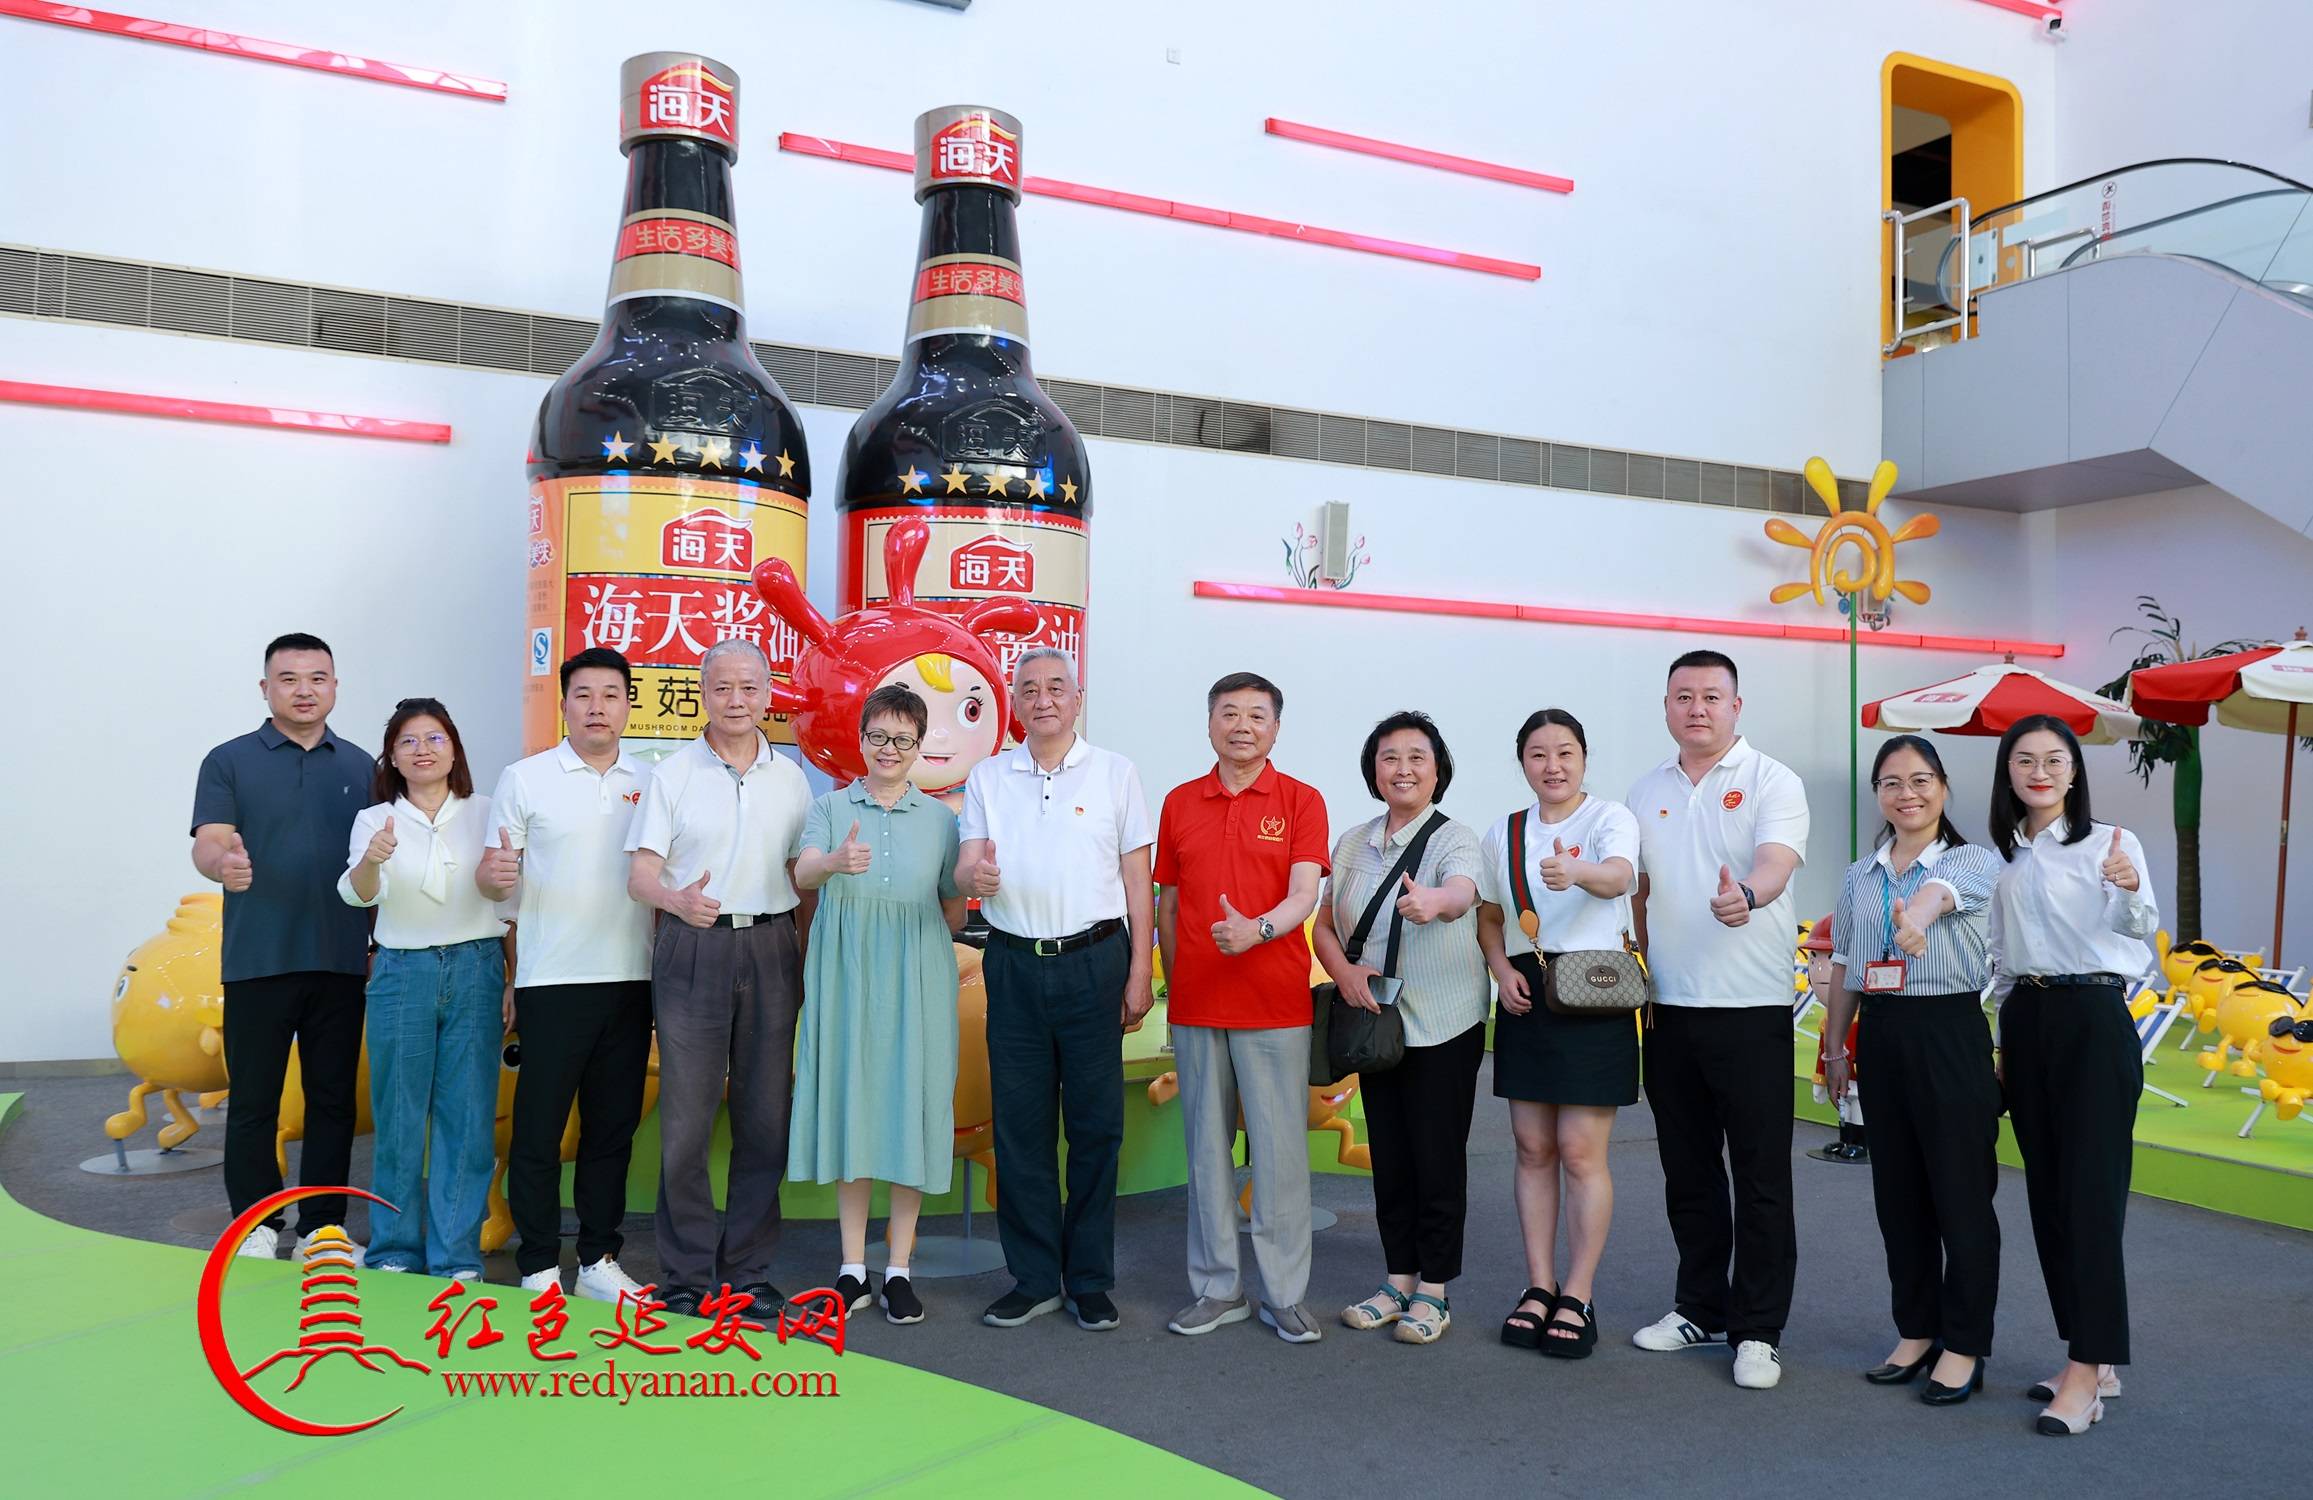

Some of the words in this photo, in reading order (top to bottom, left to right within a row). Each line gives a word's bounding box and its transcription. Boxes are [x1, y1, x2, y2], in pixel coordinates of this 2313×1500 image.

[648, 83, 730, 137] 海天
[939, 136, 1014, 182] 海天
[672, 527, 745, 567] 海天
[959, 553, 1026, 587] 海天
[630, 722, 688, 731] MUSHROOM
[1590, 975, 1617, 983] GUCCI
